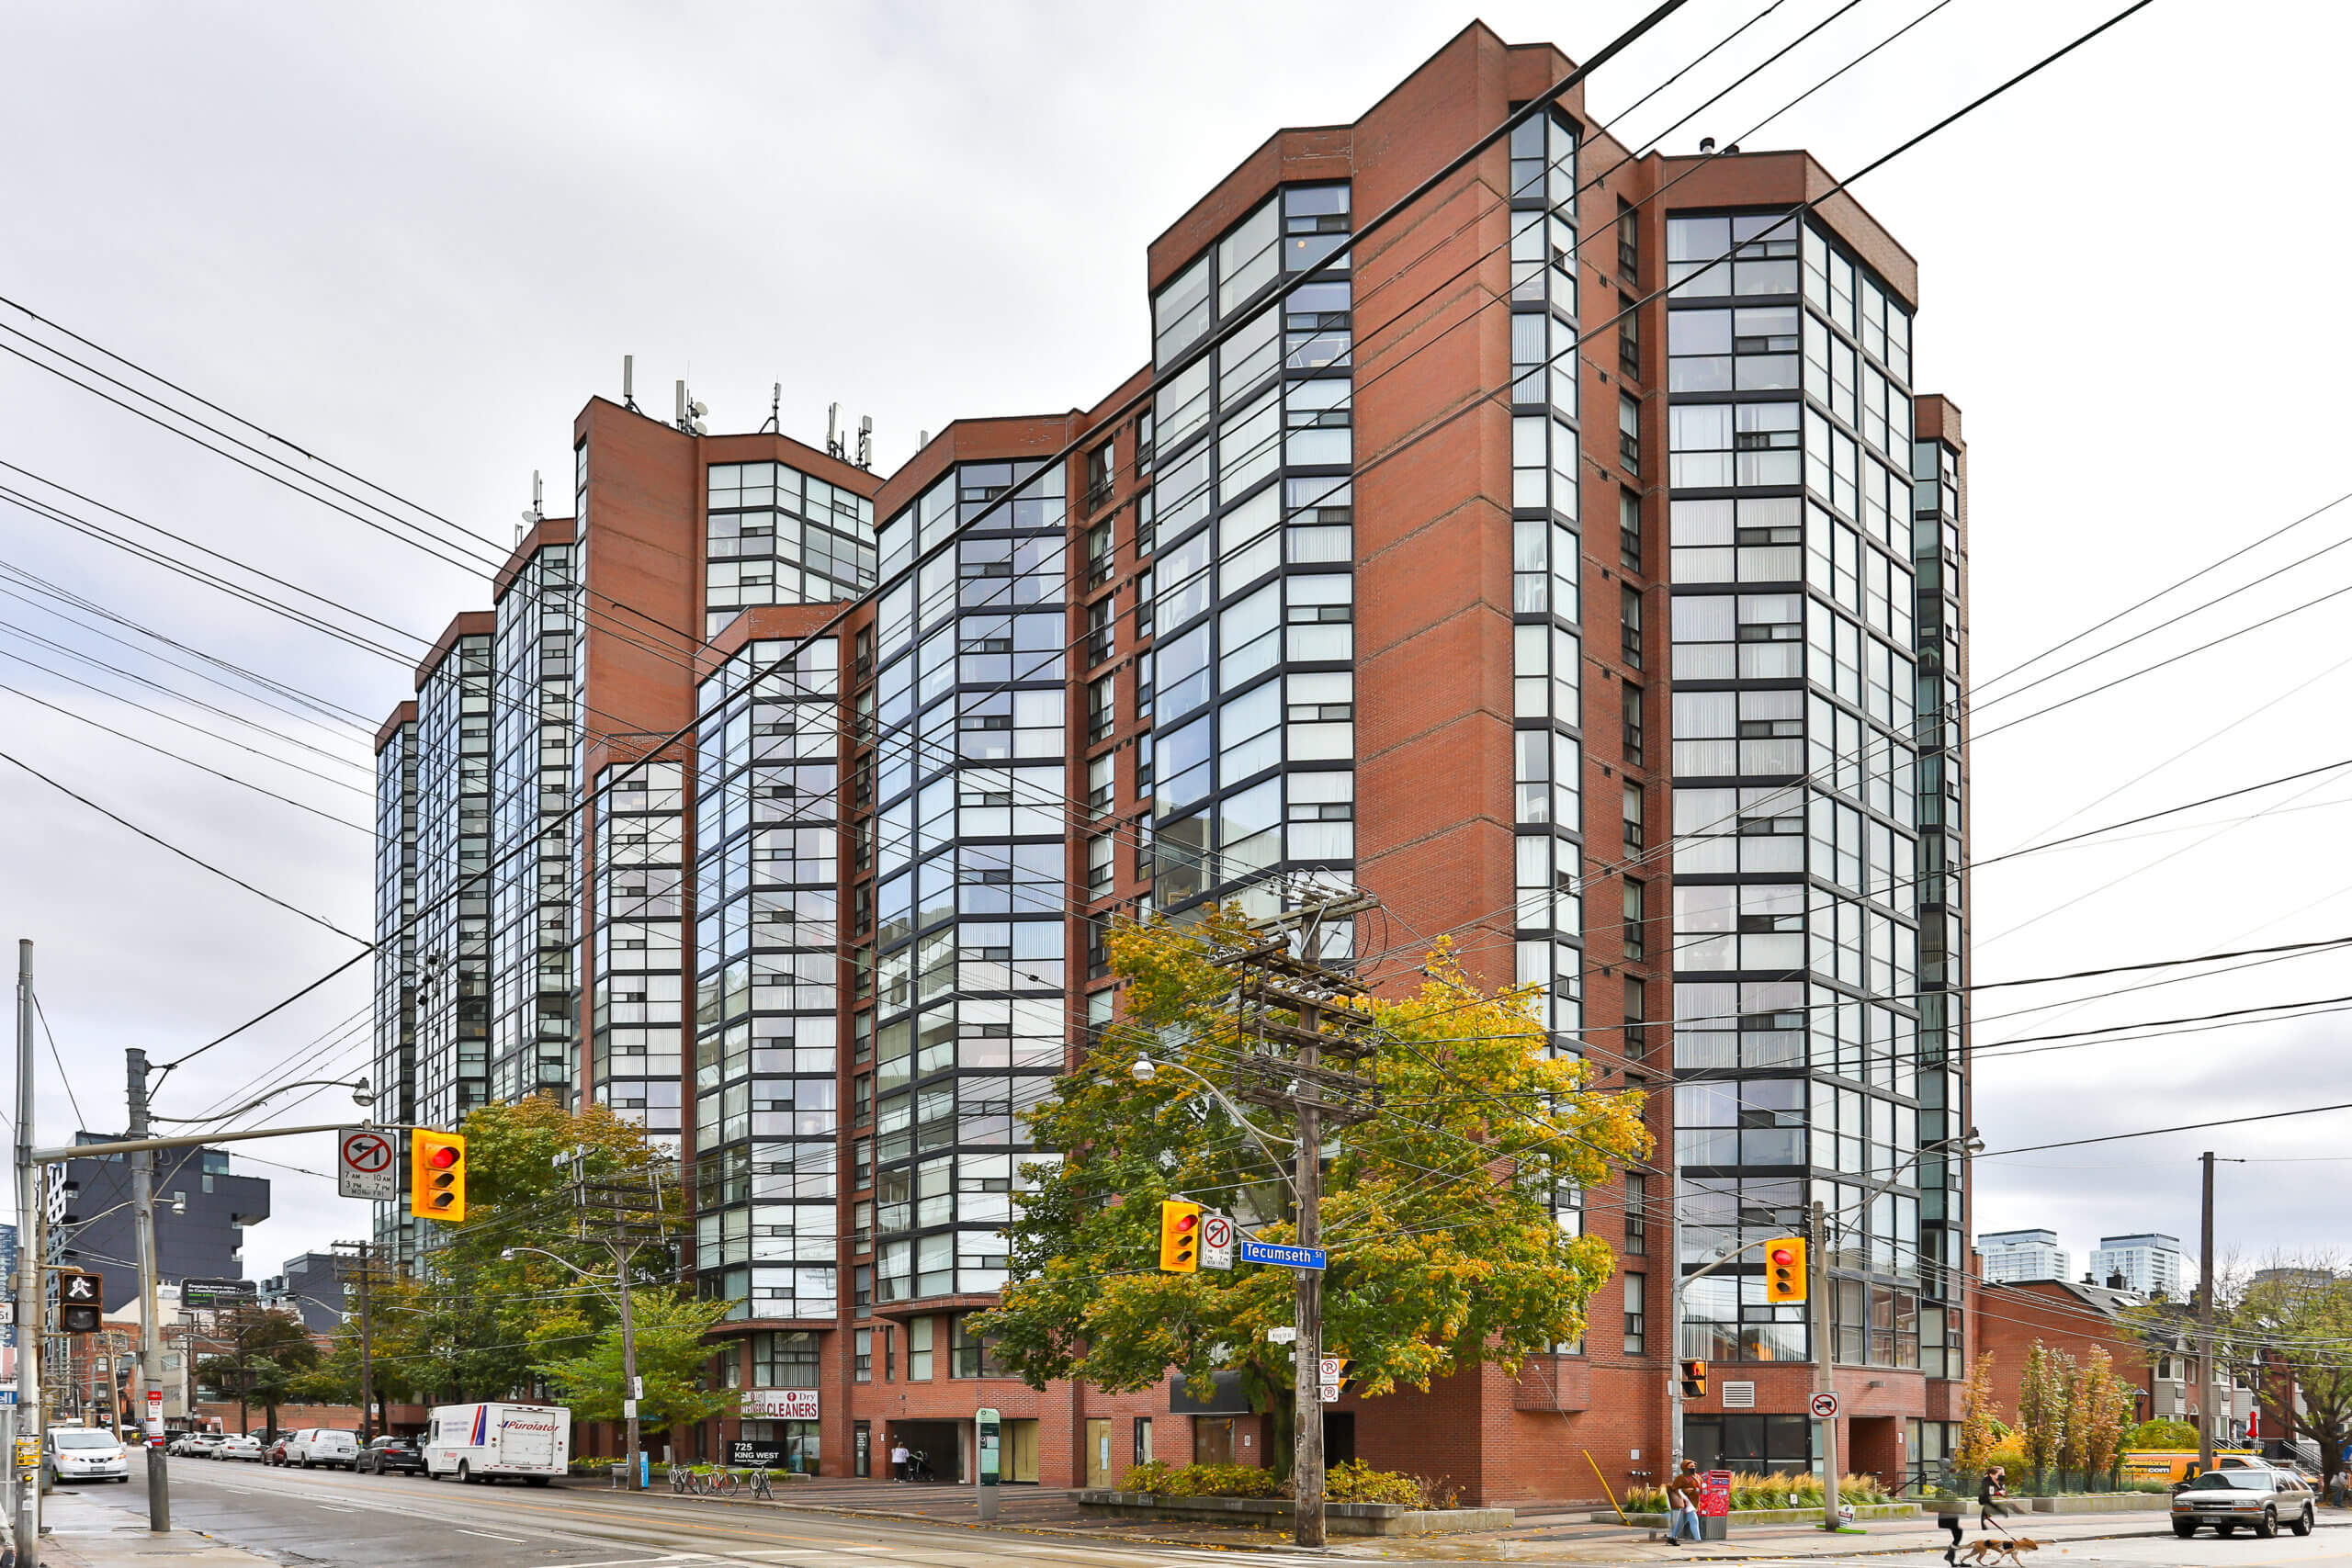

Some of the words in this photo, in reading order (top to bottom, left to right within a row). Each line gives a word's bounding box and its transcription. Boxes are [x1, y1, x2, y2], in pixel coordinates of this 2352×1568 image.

[1246, 1243, 1311, 1263] Tecumseth
[1315, 1250, 1323, 1258] St
[799, 1393, 816, 1402] Dry
[767, 1403, 817, 1417] CLEANERS
[507, 1420, 560, 1432] Purolator
